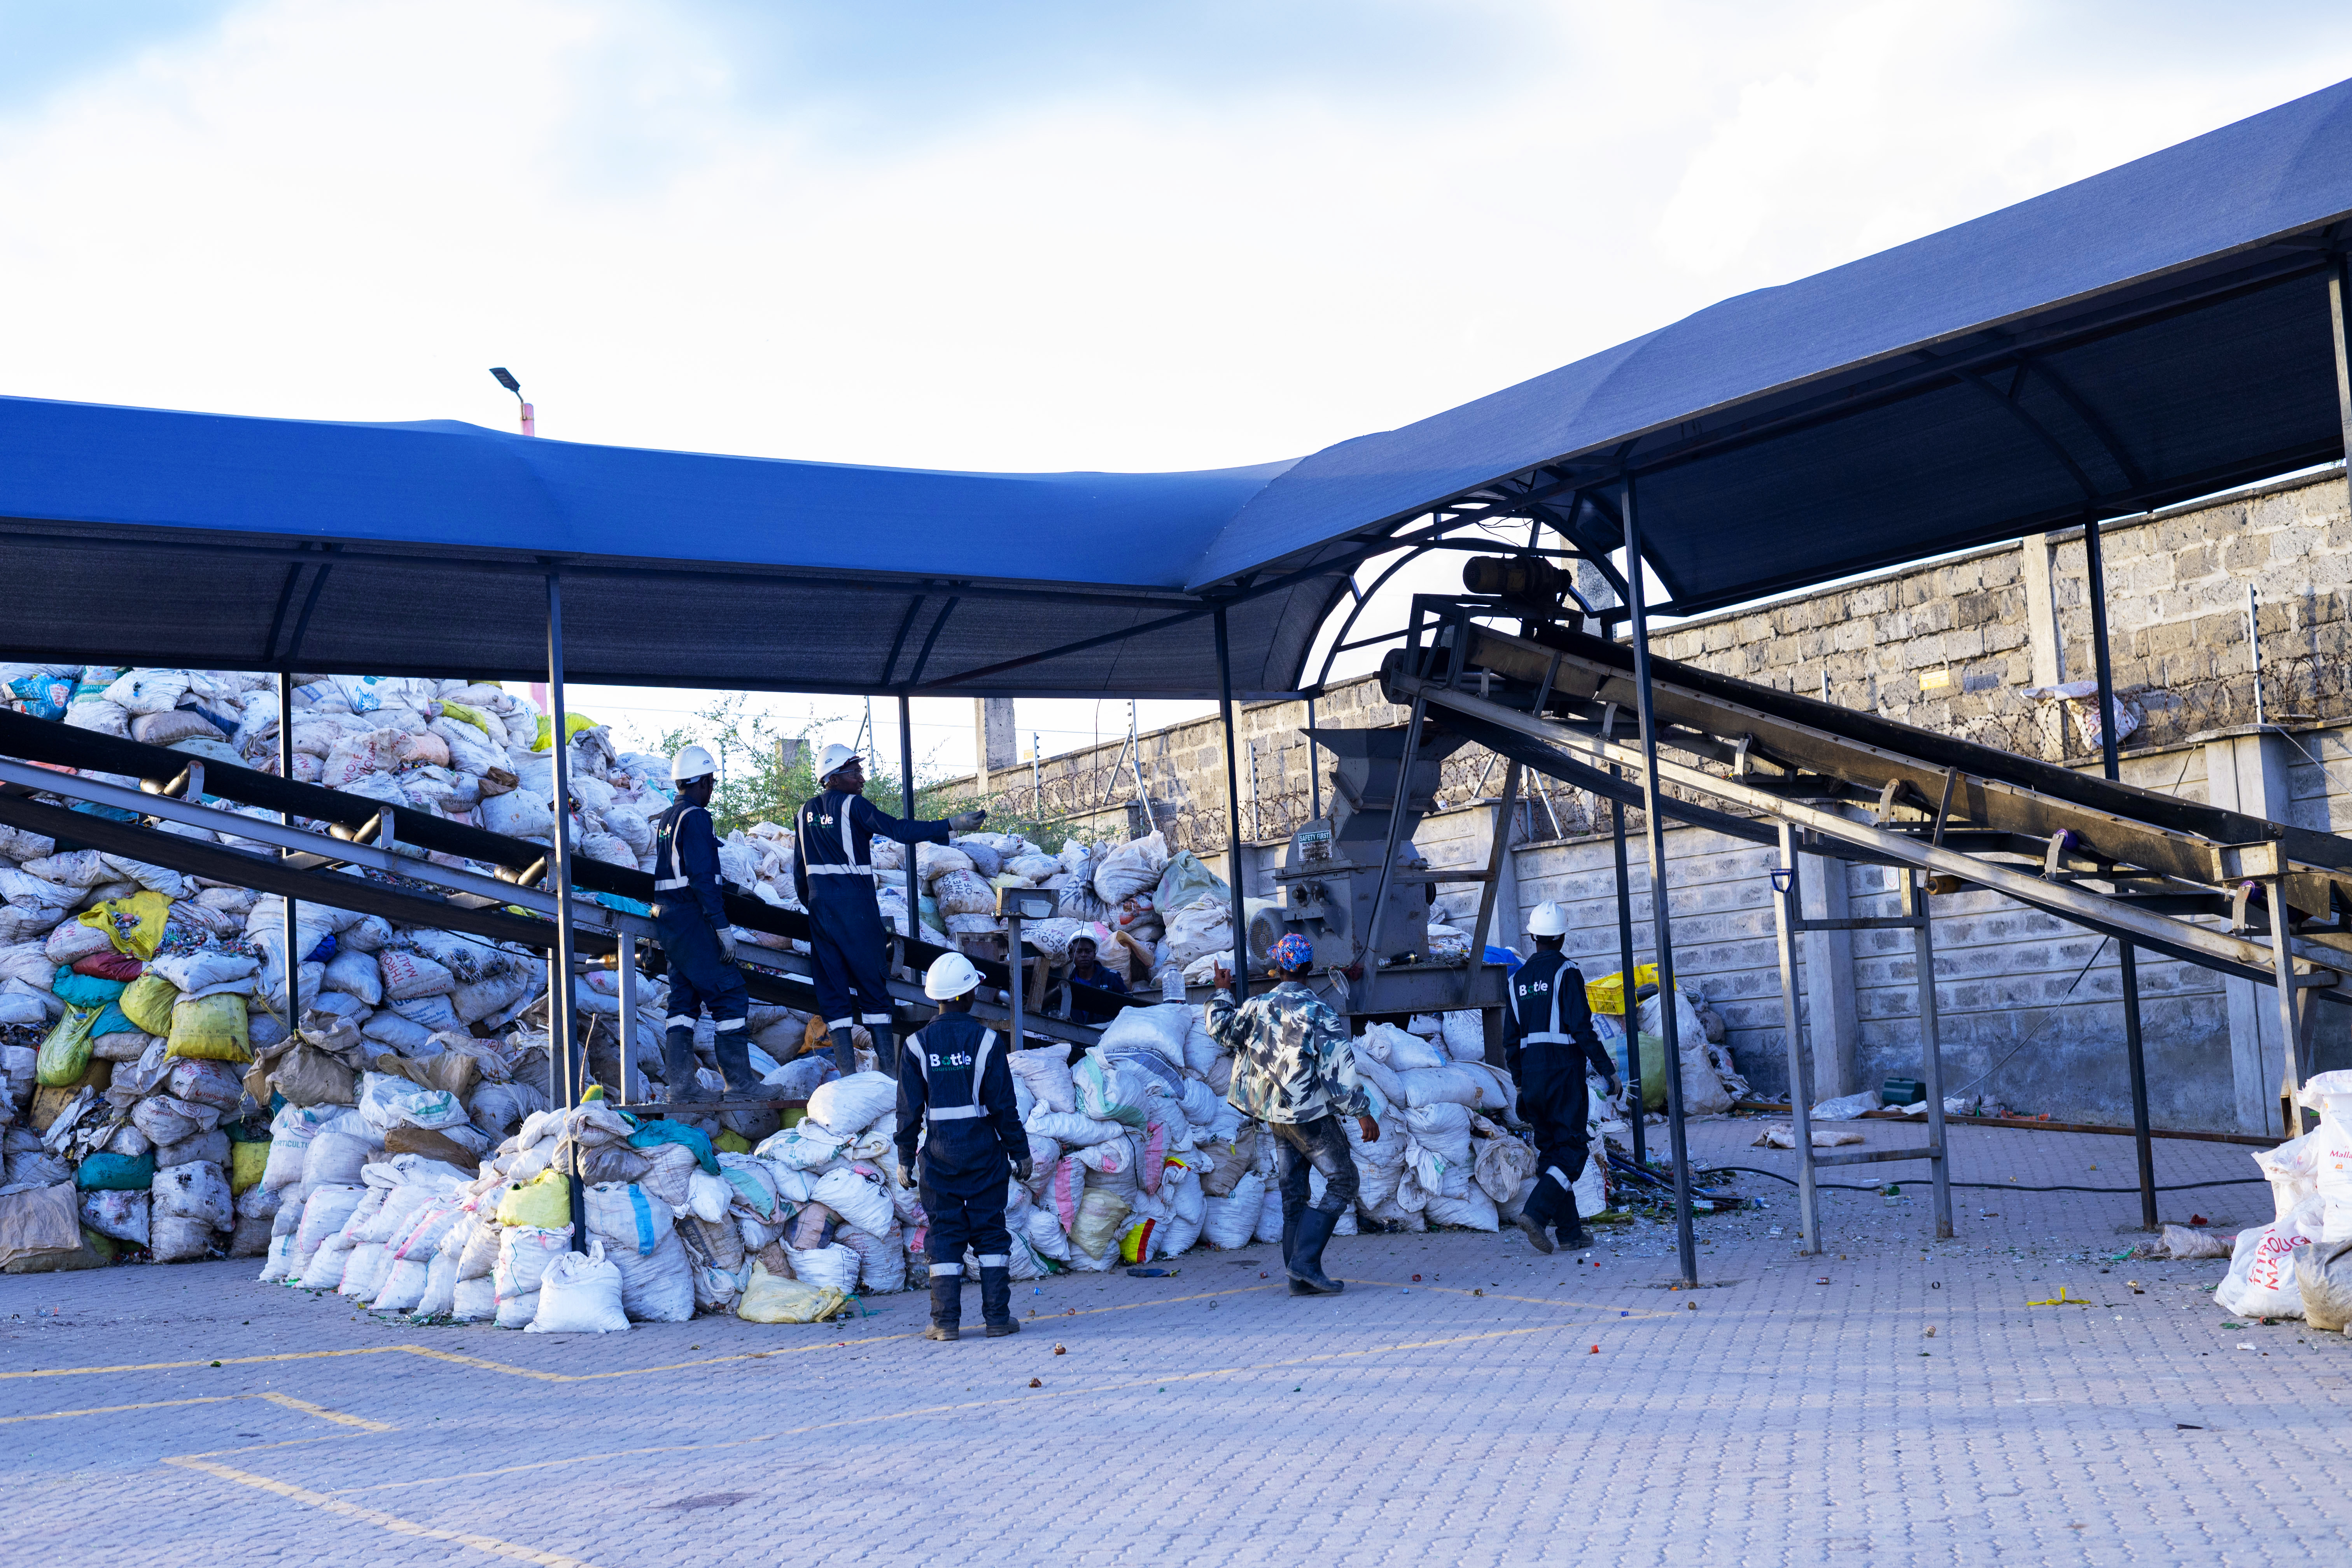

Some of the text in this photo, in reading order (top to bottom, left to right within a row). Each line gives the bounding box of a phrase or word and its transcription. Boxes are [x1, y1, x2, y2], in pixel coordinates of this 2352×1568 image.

[442, 721, 480, 747] VIKINGMALT.CO
[1299, 834, 1316, 842] SAFETY
[964, 883, 973, 895] OF
[64, 943, 104, 958] VIKING MALT
[395, 954, 418, 978] MALT
[408, 984, 447, 998] VIKING MALT
[2329, 1150, 2352, 1159] Malla
